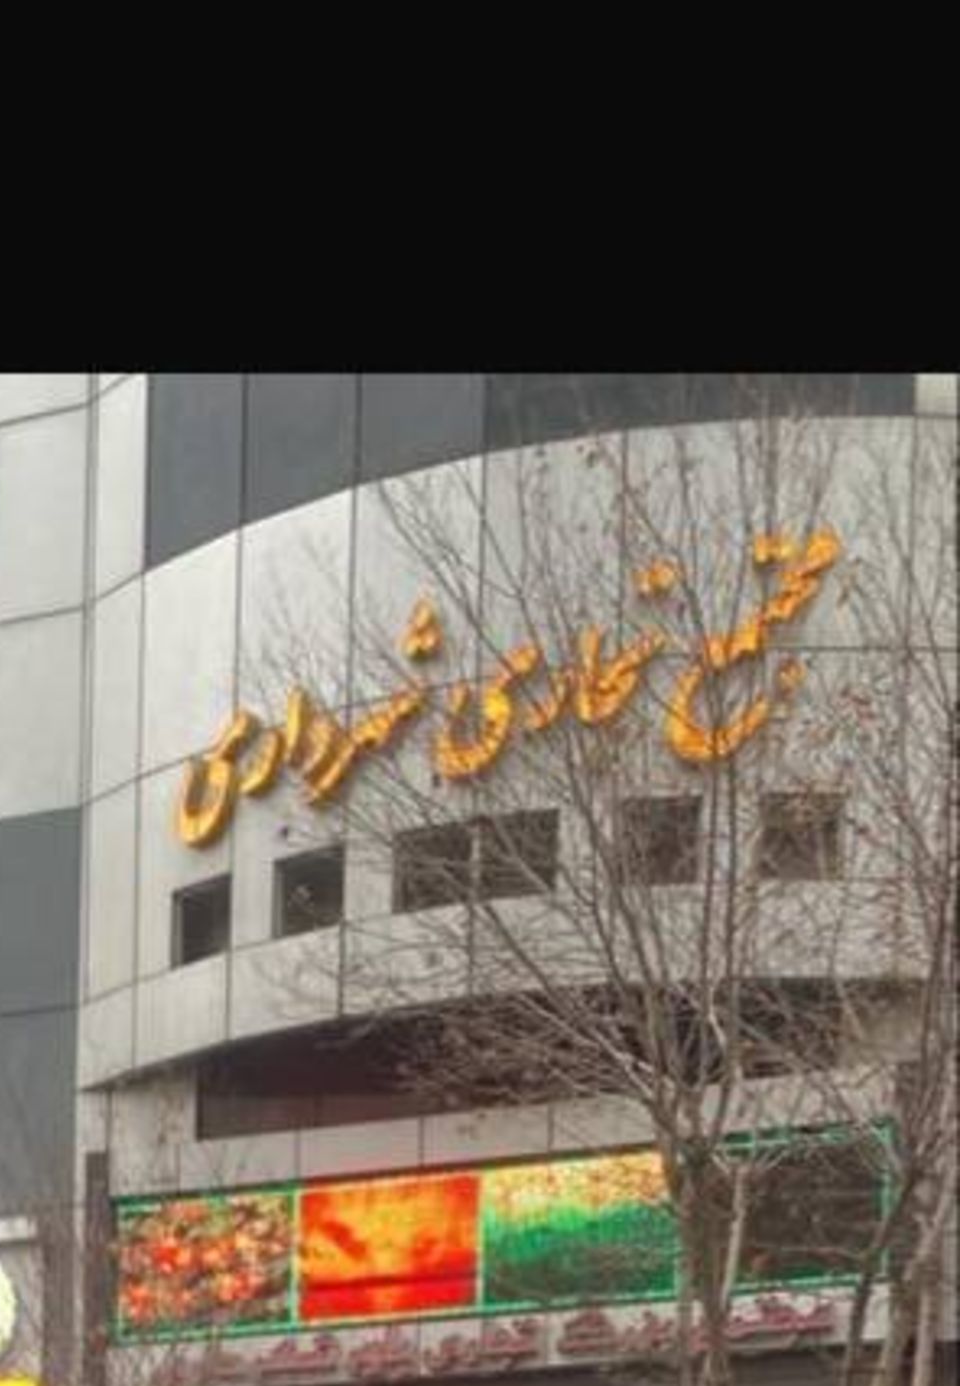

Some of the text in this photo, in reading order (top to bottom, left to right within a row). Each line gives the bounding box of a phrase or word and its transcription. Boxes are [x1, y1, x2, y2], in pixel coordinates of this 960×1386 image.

[175, 528, 837, 846] مجتمع تجاری شهرداری
